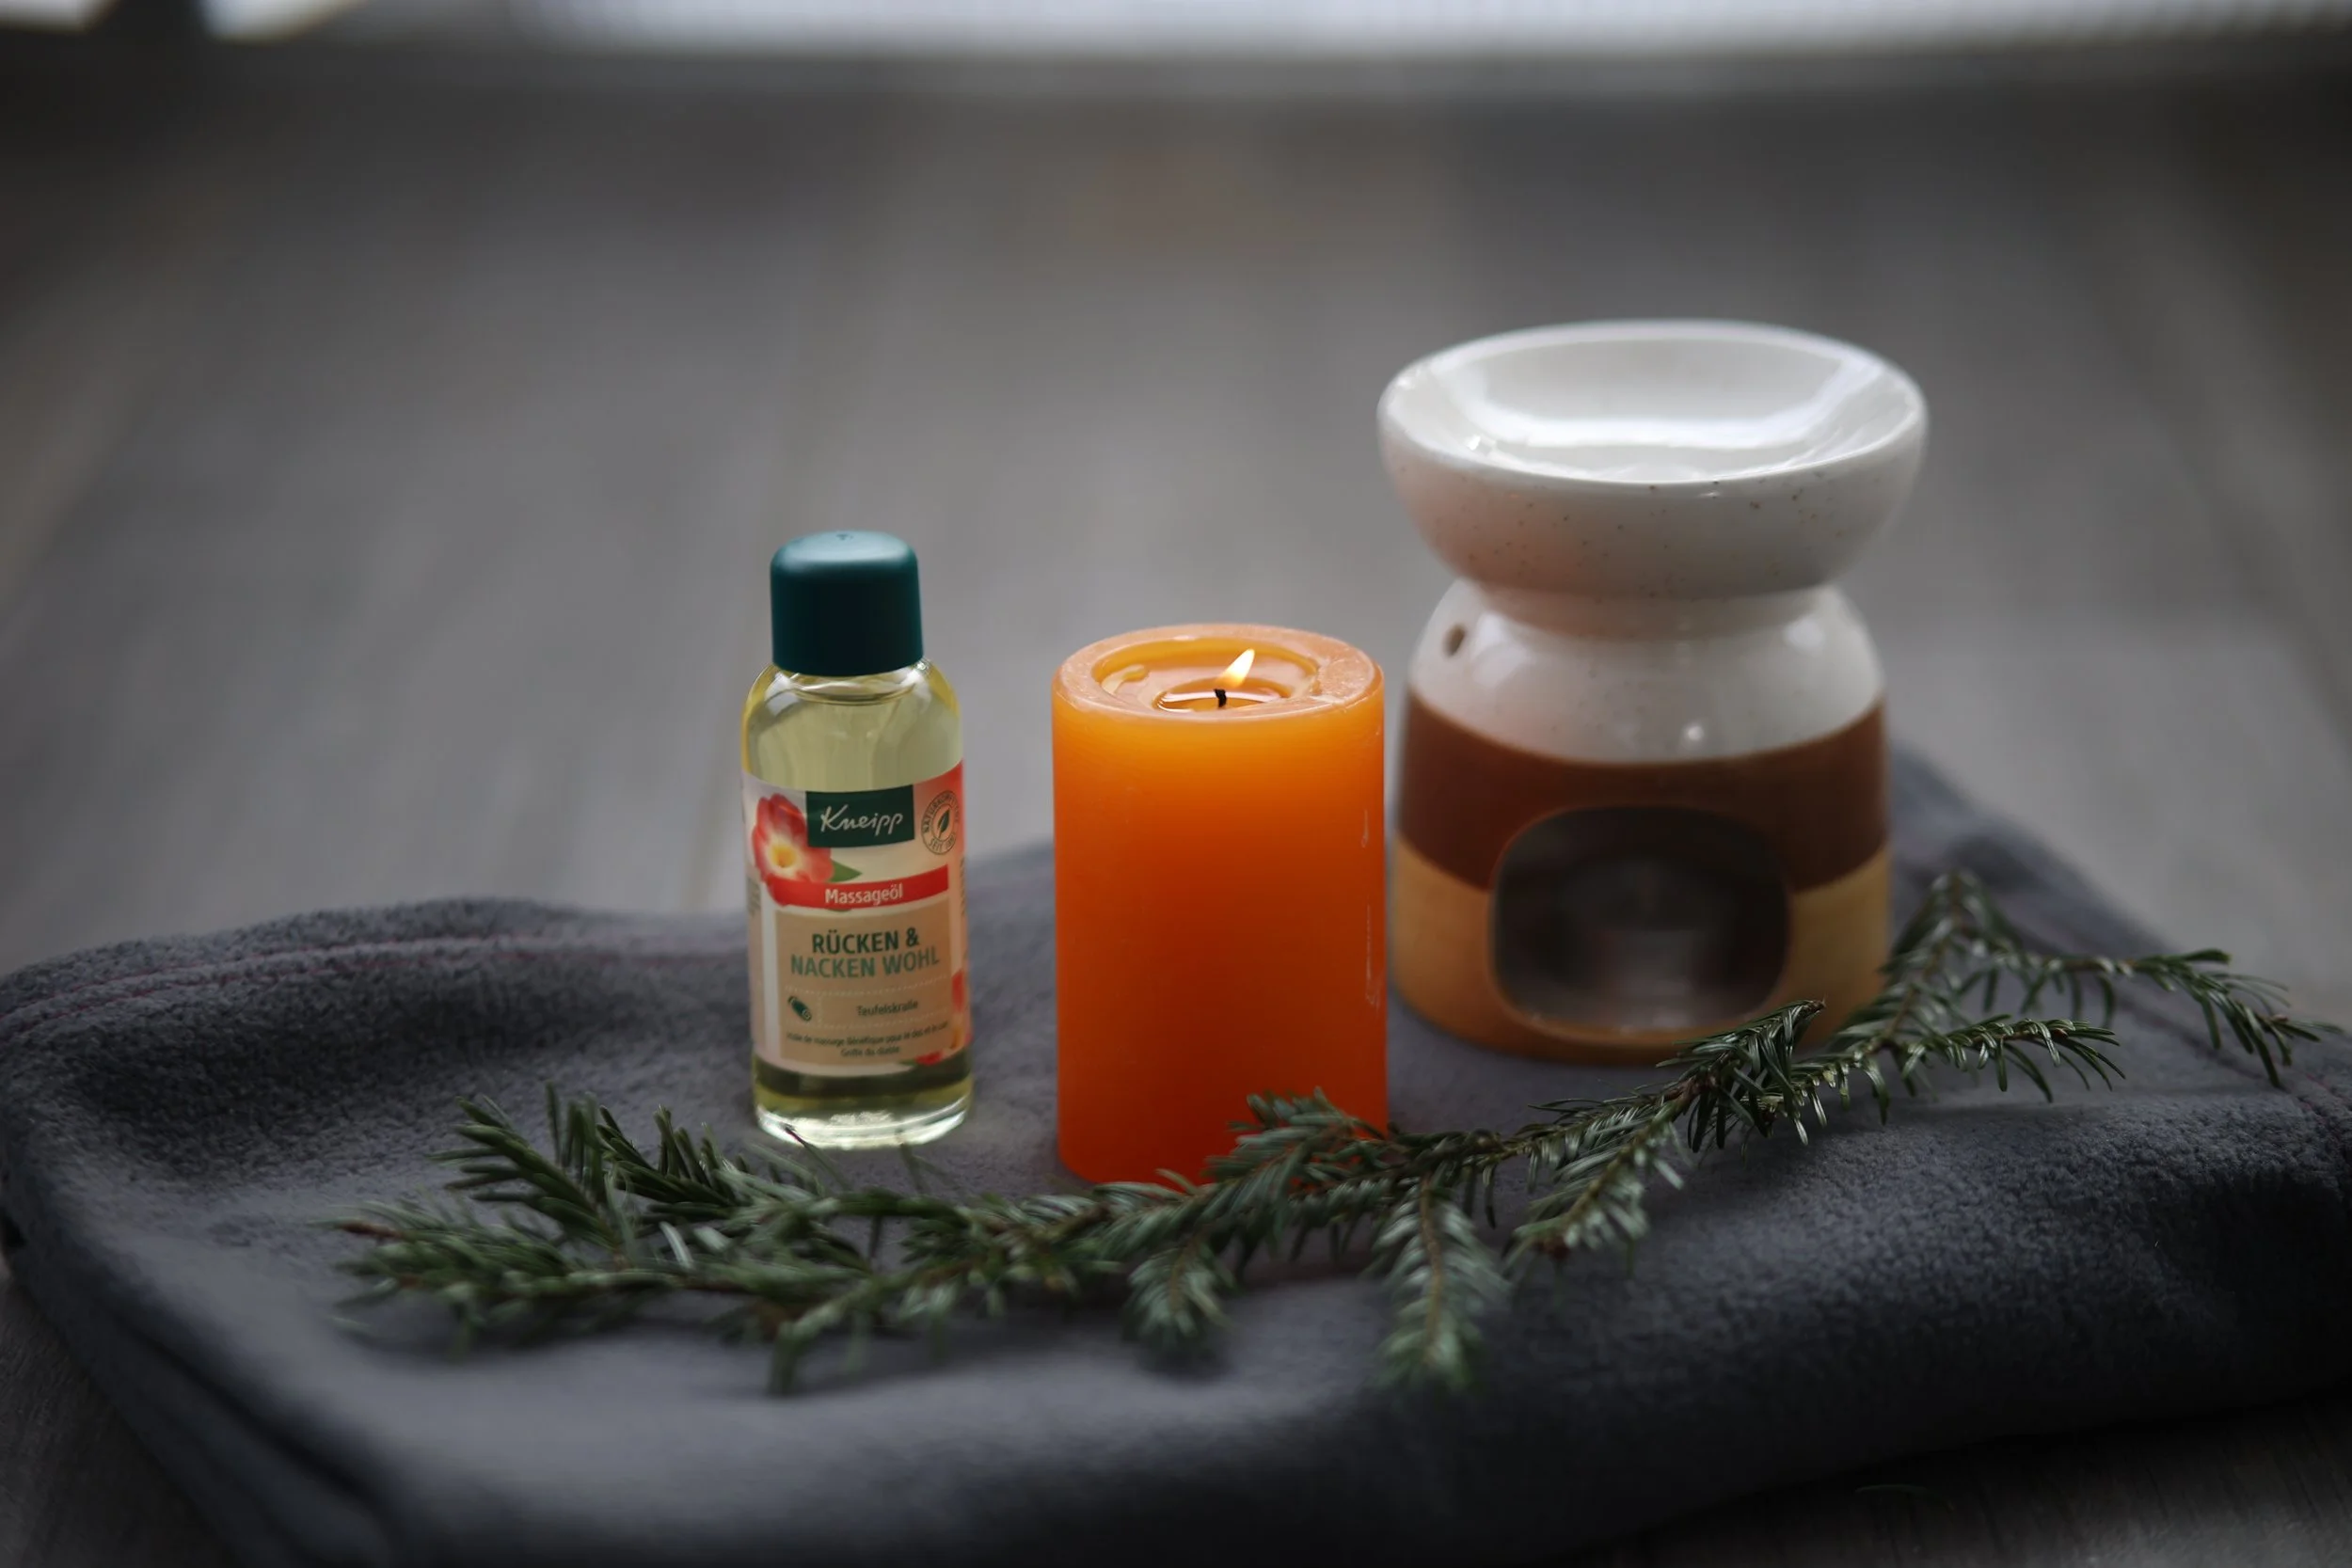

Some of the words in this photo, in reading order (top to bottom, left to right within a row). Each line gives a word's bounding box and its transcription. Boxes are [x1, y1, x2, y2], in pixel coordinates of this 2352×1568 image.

[820, 804, 904, 836] Kneipp
[824, 883, 903, 906] Massageöl
[812, 929, 898, 955] RÜCKEN
[906, 927, 920, 947] &
[790, 955, 876, 978] NACKEN
[882, 945, 941, 976] WOHL
